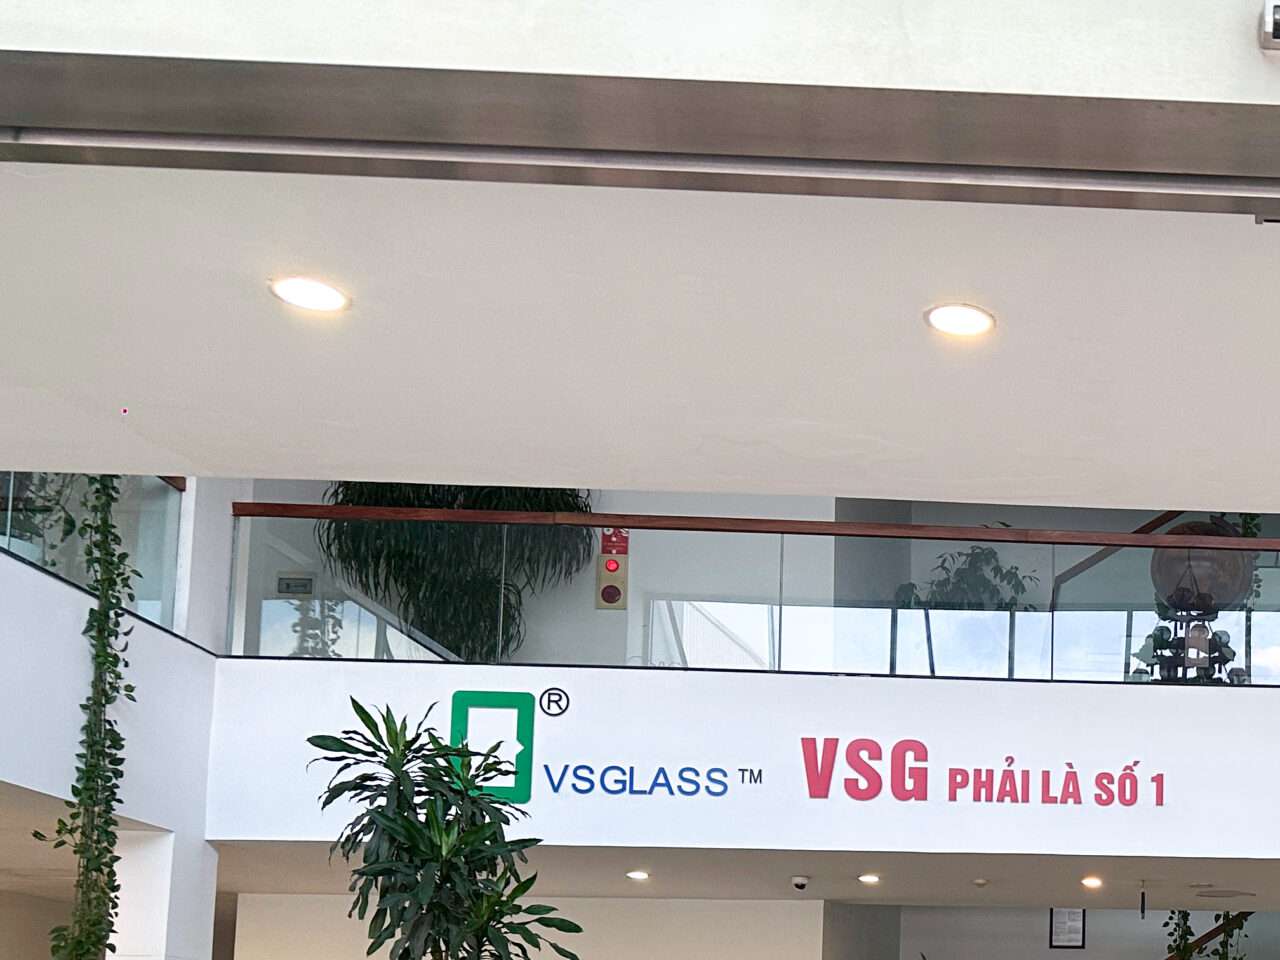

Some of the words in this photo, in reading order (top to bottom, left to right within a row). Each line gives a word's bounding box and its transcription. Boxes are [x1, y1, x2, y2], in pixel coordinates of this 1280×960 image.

[544, 764, 728, 796] VSGLASS
[801, 737, 928, 801] VSG
[948, 756, 1030, 803] PHẢI
[1041, 762, 1081, 805] LÀ
[1094, 760, 1140, 807] SỐ
[1151, 773, 1164, 806] 1
